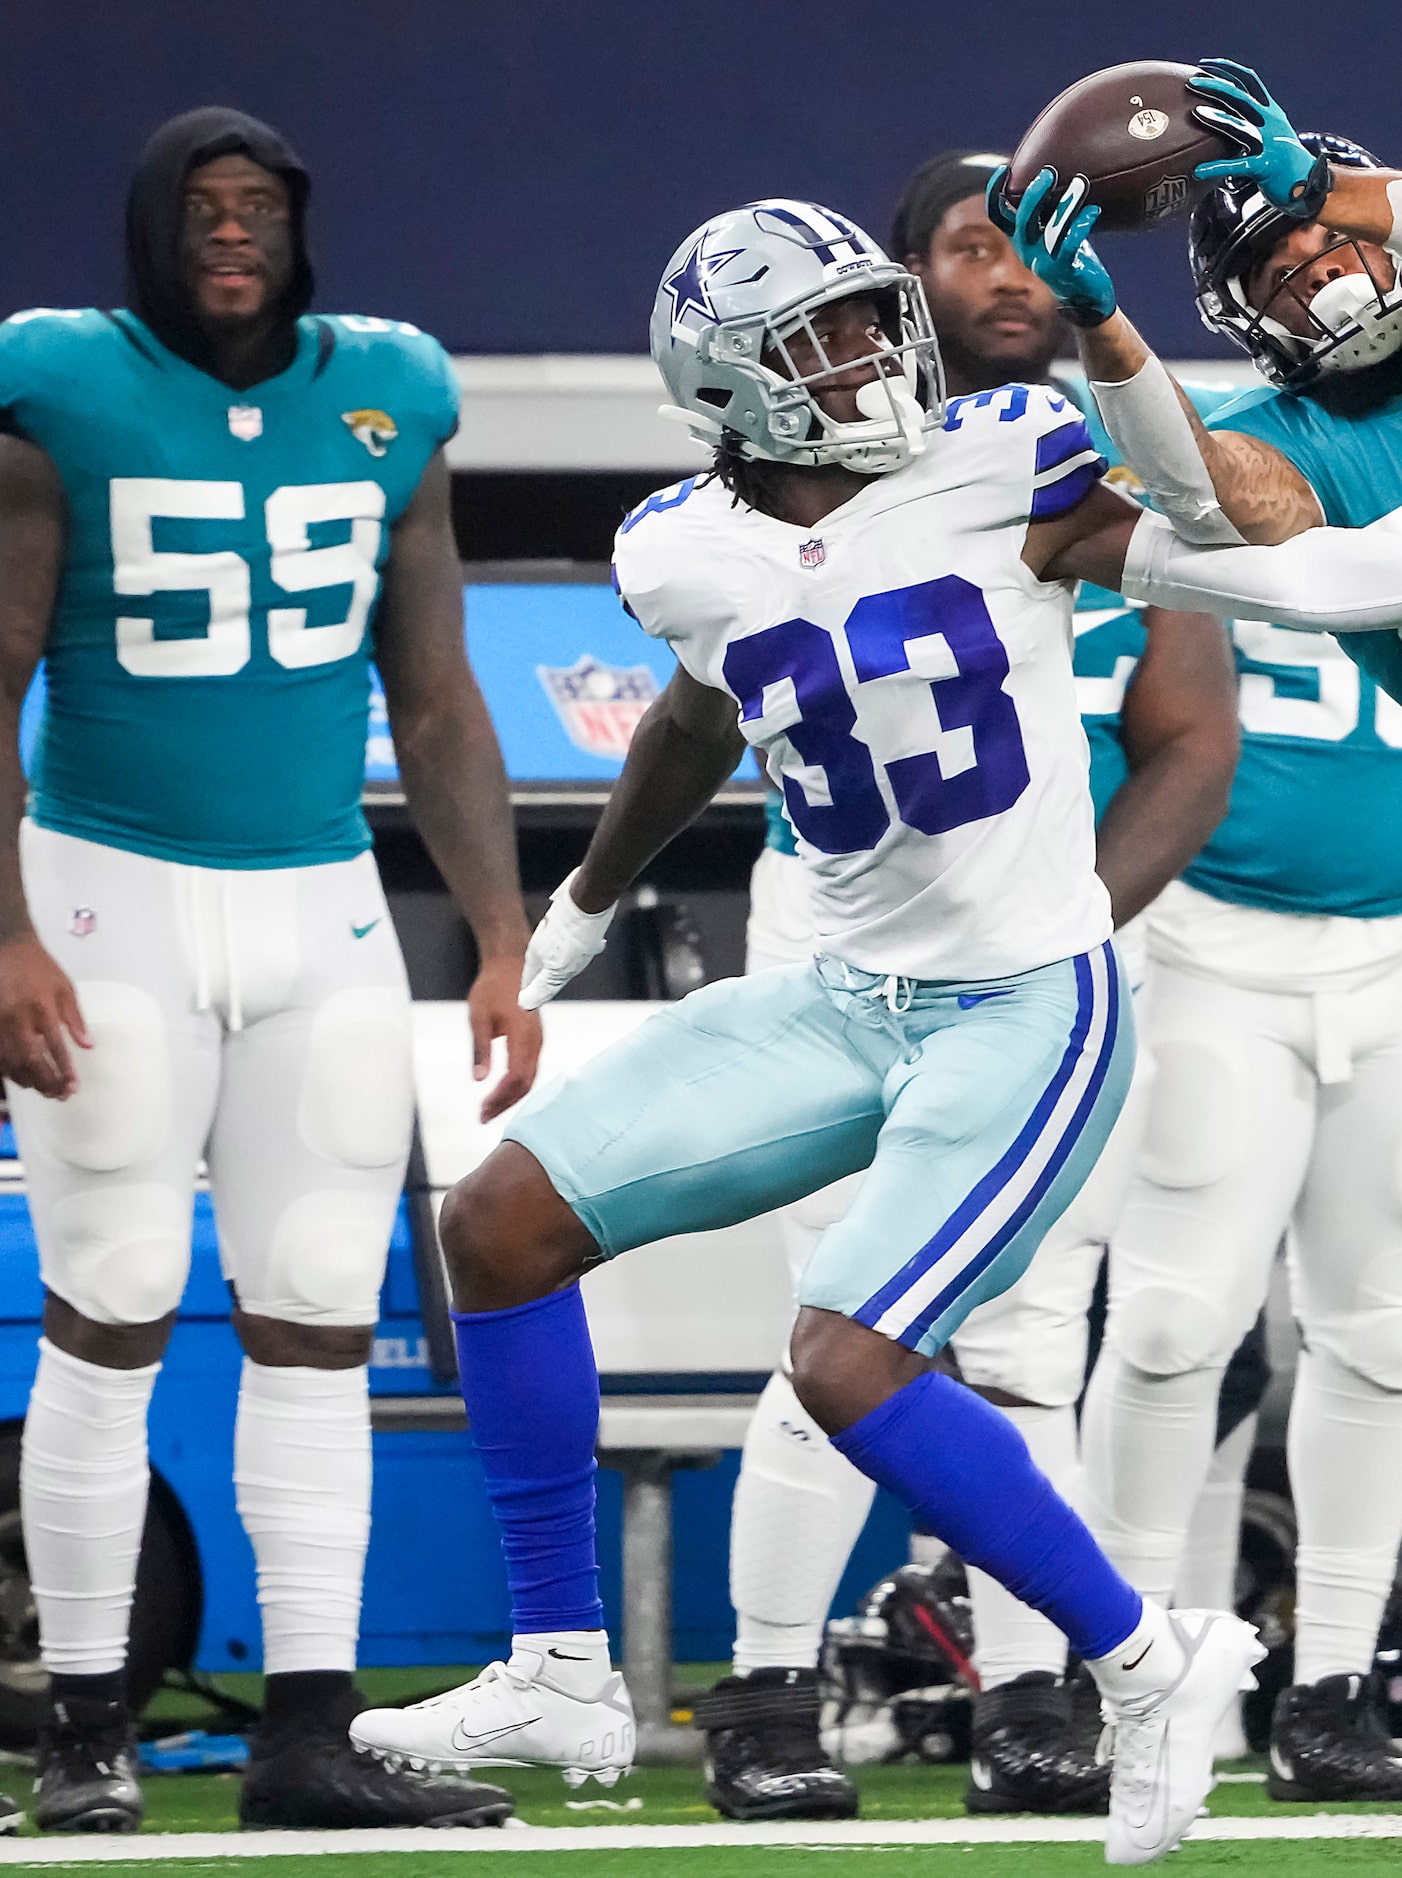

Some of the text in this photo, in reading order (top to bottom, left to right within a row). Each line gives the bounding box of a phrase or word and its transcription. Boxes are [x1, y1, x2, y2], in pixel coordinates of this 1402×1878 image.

[1136, 110, 1156, 127] 154
[1147, 180, 1185, 209] NFL
[109, 477, 387, 678] 59
[721, 573, 1032, 855] 33
